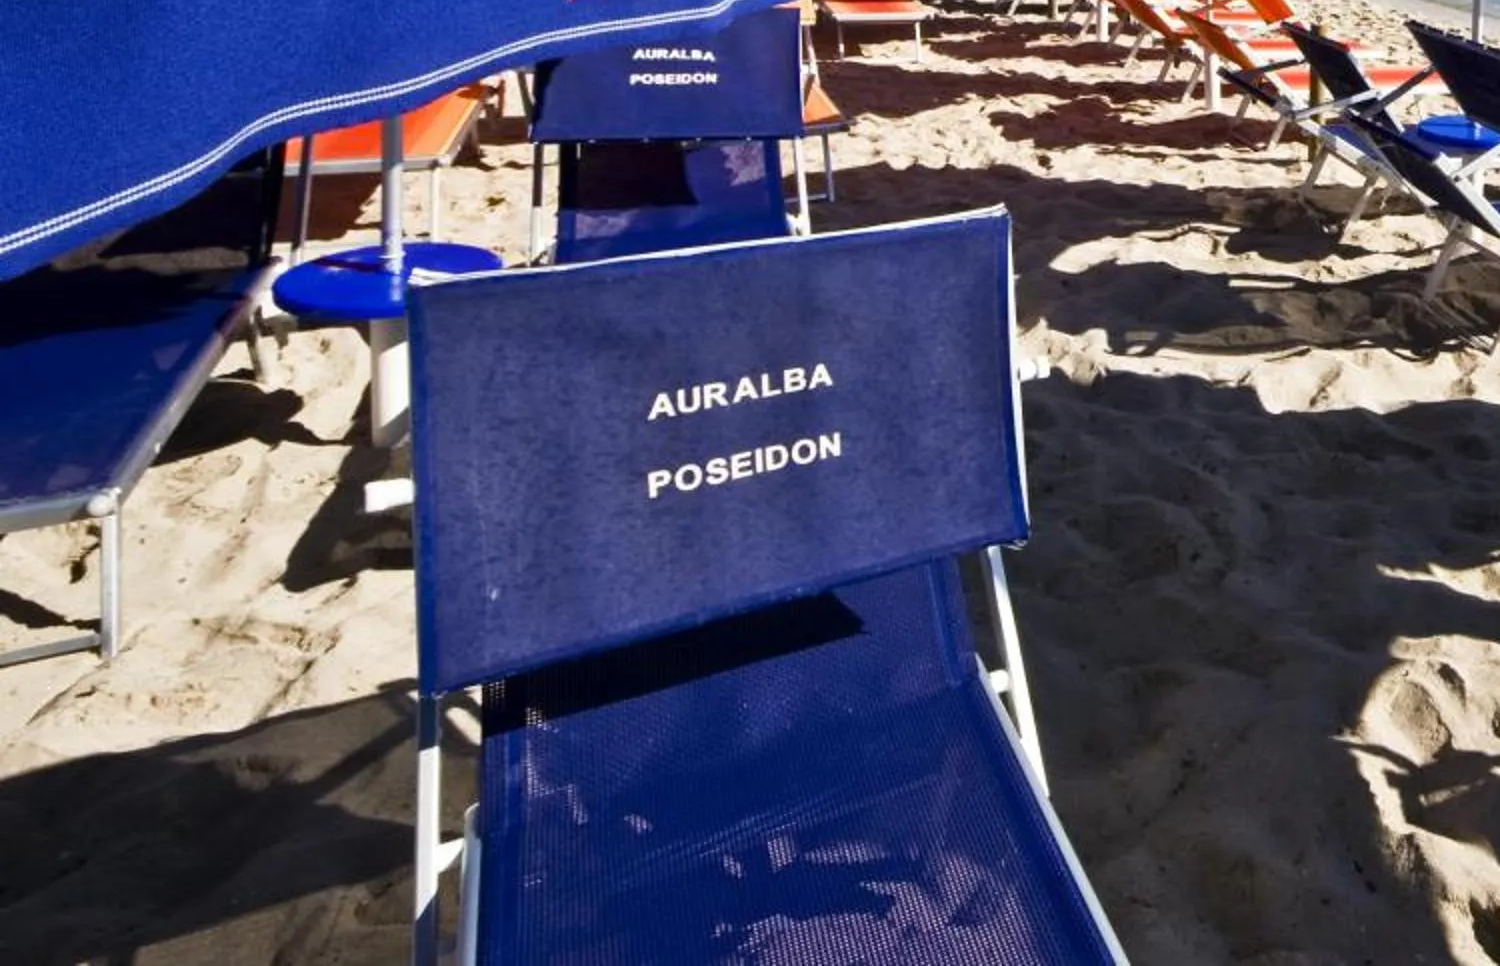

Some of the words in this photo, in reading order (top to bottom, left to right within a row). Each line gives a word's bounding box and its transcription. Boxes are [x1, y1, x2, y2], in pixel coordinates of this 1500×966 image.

[632, 48, 716, 62] AURALBA
[629, 72, 718, 85] POSEIDON
[647, 363, 834, 421] AURALBA
[647, 432, 842, 499] POSEIDON
